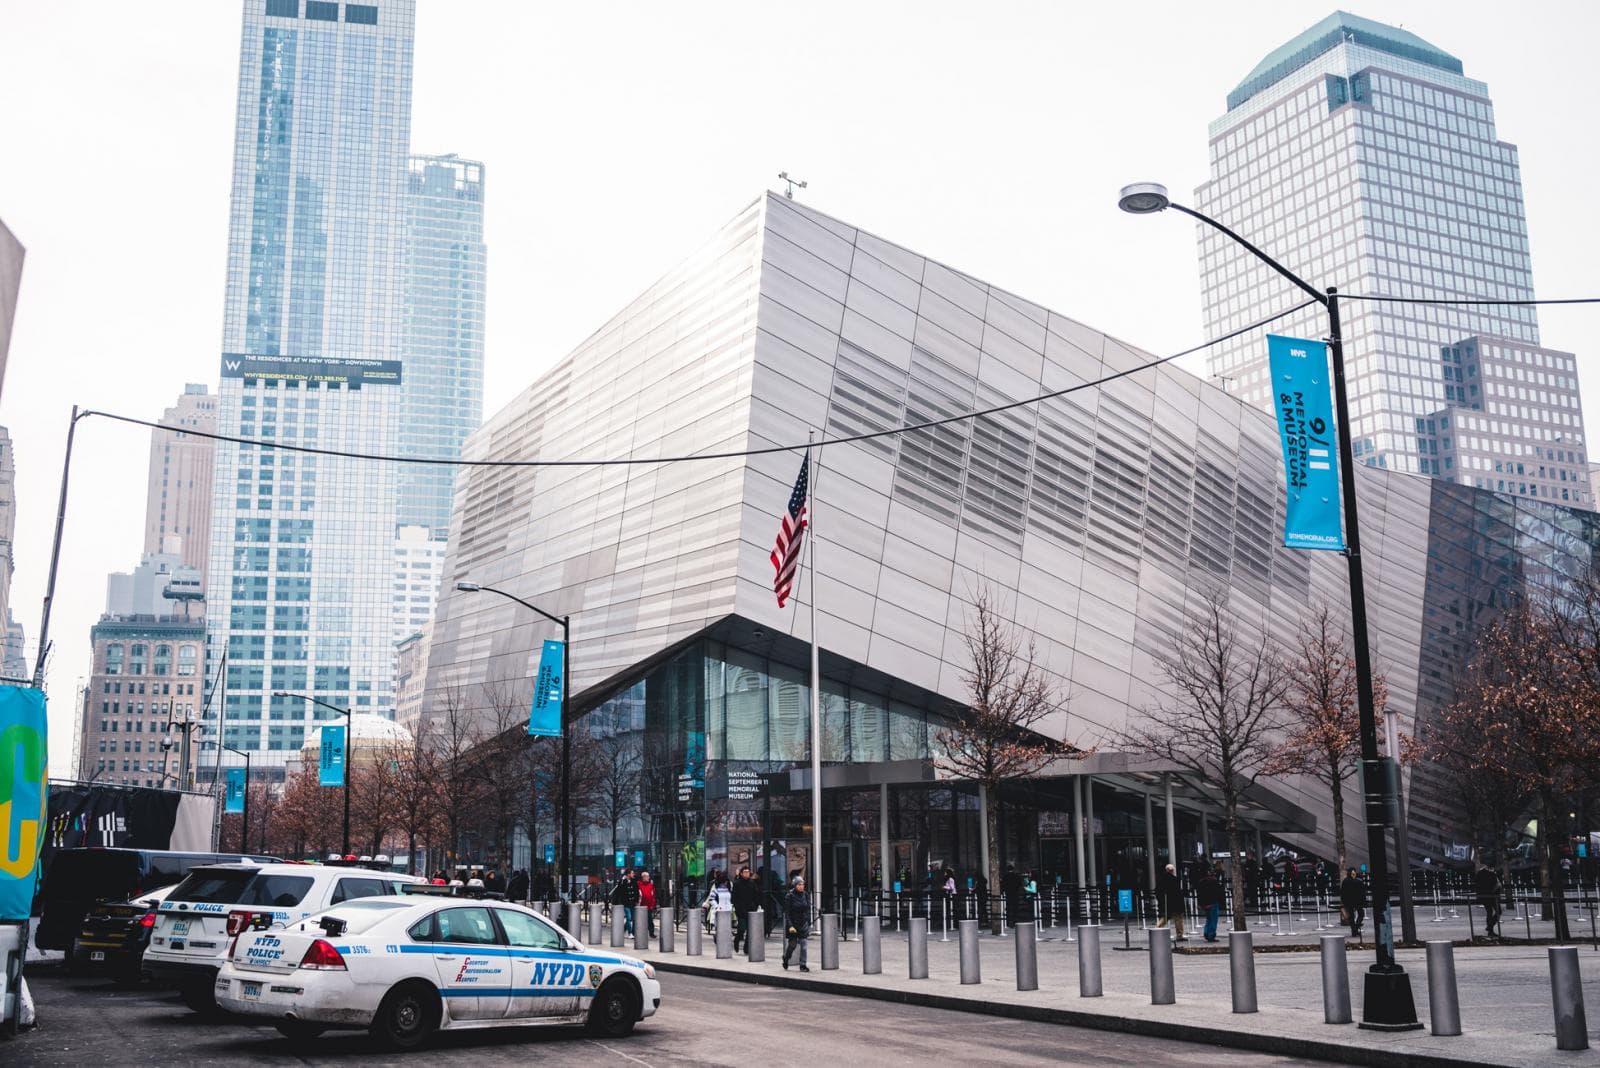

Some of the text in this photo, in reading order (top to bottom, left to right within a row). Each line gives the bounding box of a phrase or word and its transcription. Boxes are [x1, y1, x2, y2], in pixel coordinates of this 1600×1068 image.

[225, 359, 241, 371] W
[257, 355, 292, 363] RESIDENCES
[1280, 393, 1299, 488] & MUSEUM
[1293, 391, 1308, 488] MEMORIAL
[1309, 417, 1330, 470] 9/11
[549, 676, 560, 701] 9/11
[193, 903, 224, 912] POLICE
[254, 937, 281, 947] NYPD
[247, 947, 280, 959] POLICE
[464, 956, 489, 965] COURTESY
[460, 965, 502, 974] PROFESSIONALISM
[530, 962, 585, 985] NYPD
[455, 973, 478, 982] RESPECT
